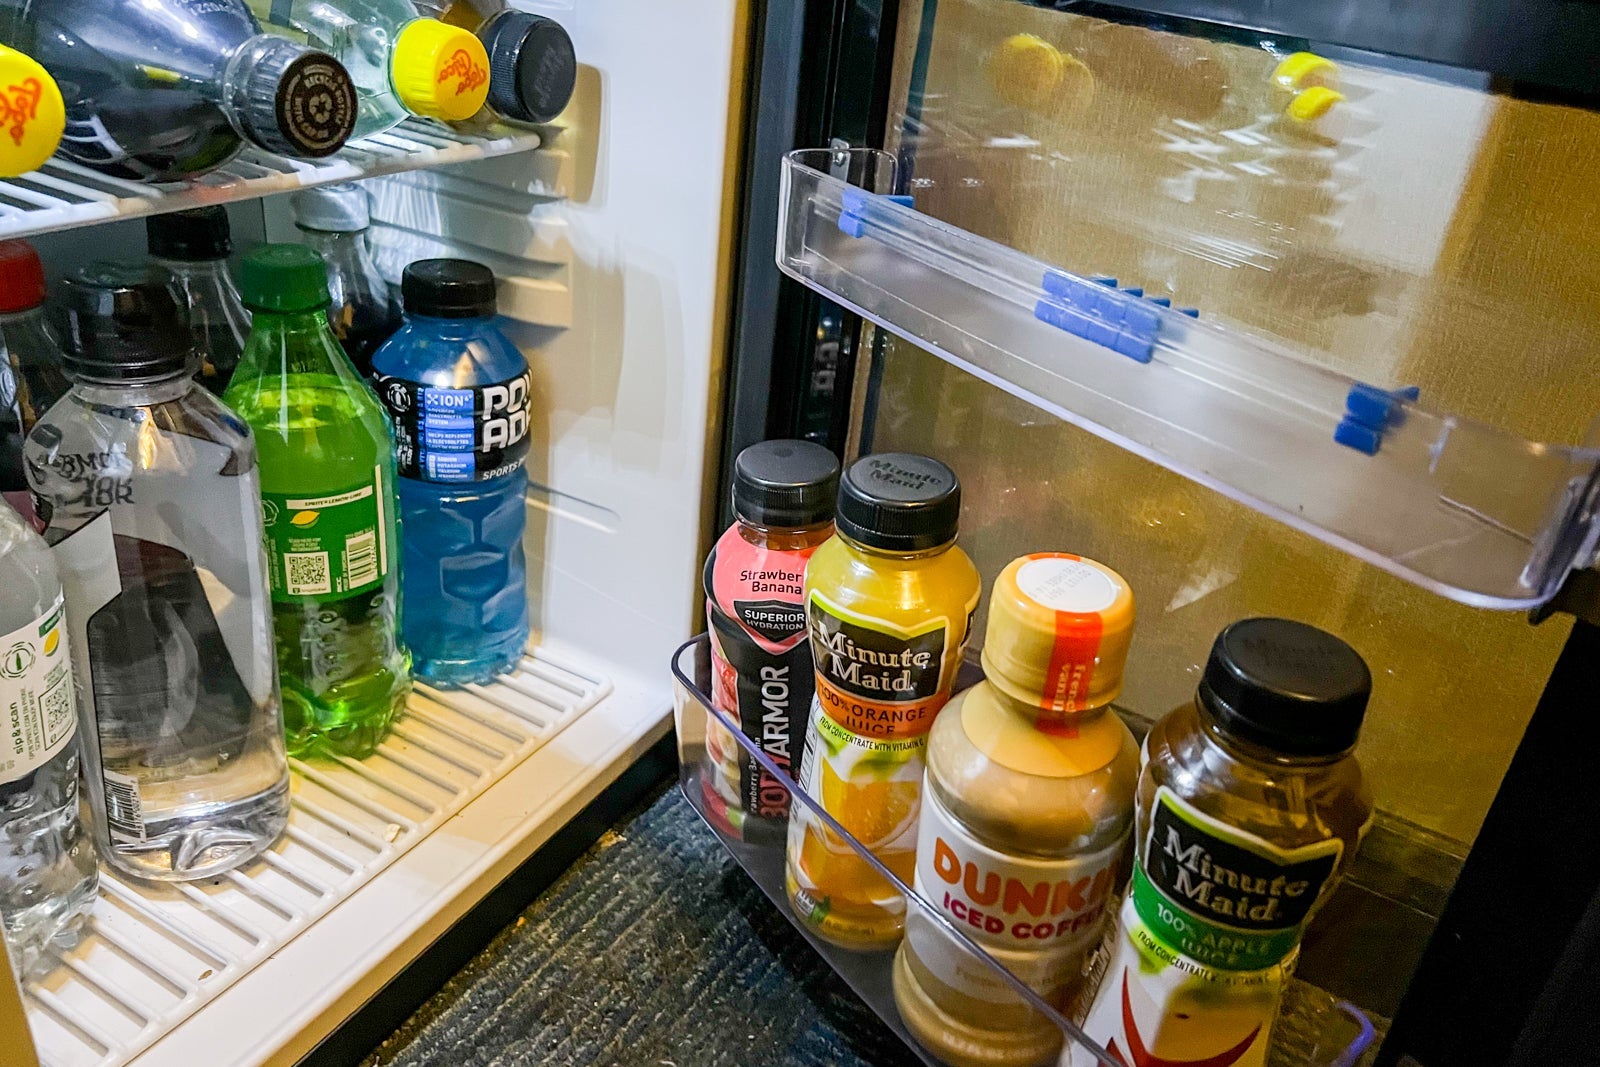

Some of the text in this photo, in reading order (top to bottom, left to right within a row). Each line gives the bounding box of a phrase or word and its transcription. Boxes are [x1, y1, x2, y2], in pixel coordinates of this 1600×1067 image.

[483, 464, 518, 481] SPORTS
[869, 459, 942, 485] Minute
[870, 469, 926, 489] Maid
[740, 569, 802, 583] Strawber
[751, 581, 802, 595] Banana
[744, 609, 805, 622] SUPERIOR
[746, 619, 804, 631] HYDRATION
[817, 619, 931, 668] Minute
[830, 652, 913, 692] Maid
[10, 702, 21, 729] scan
[851, 704, 928, 723] ORANGE
[13, 739, 24, 755] sip
[820, 716, 832, 731] FROM
[831, 726, 873, 750] CONCENTRATE
[874, 741, 891, 752] WITH
[892, 741, 918, 752] VITAMIN
[1164, 824, 1310, 898] Minute
[1173, 864, 1280, 922] Maid
[943, 890, 1005, 934] ICED
[1138, 931, 1156, 951] FROM
[1155, 945, 1209, 980] CONCENTRATE
